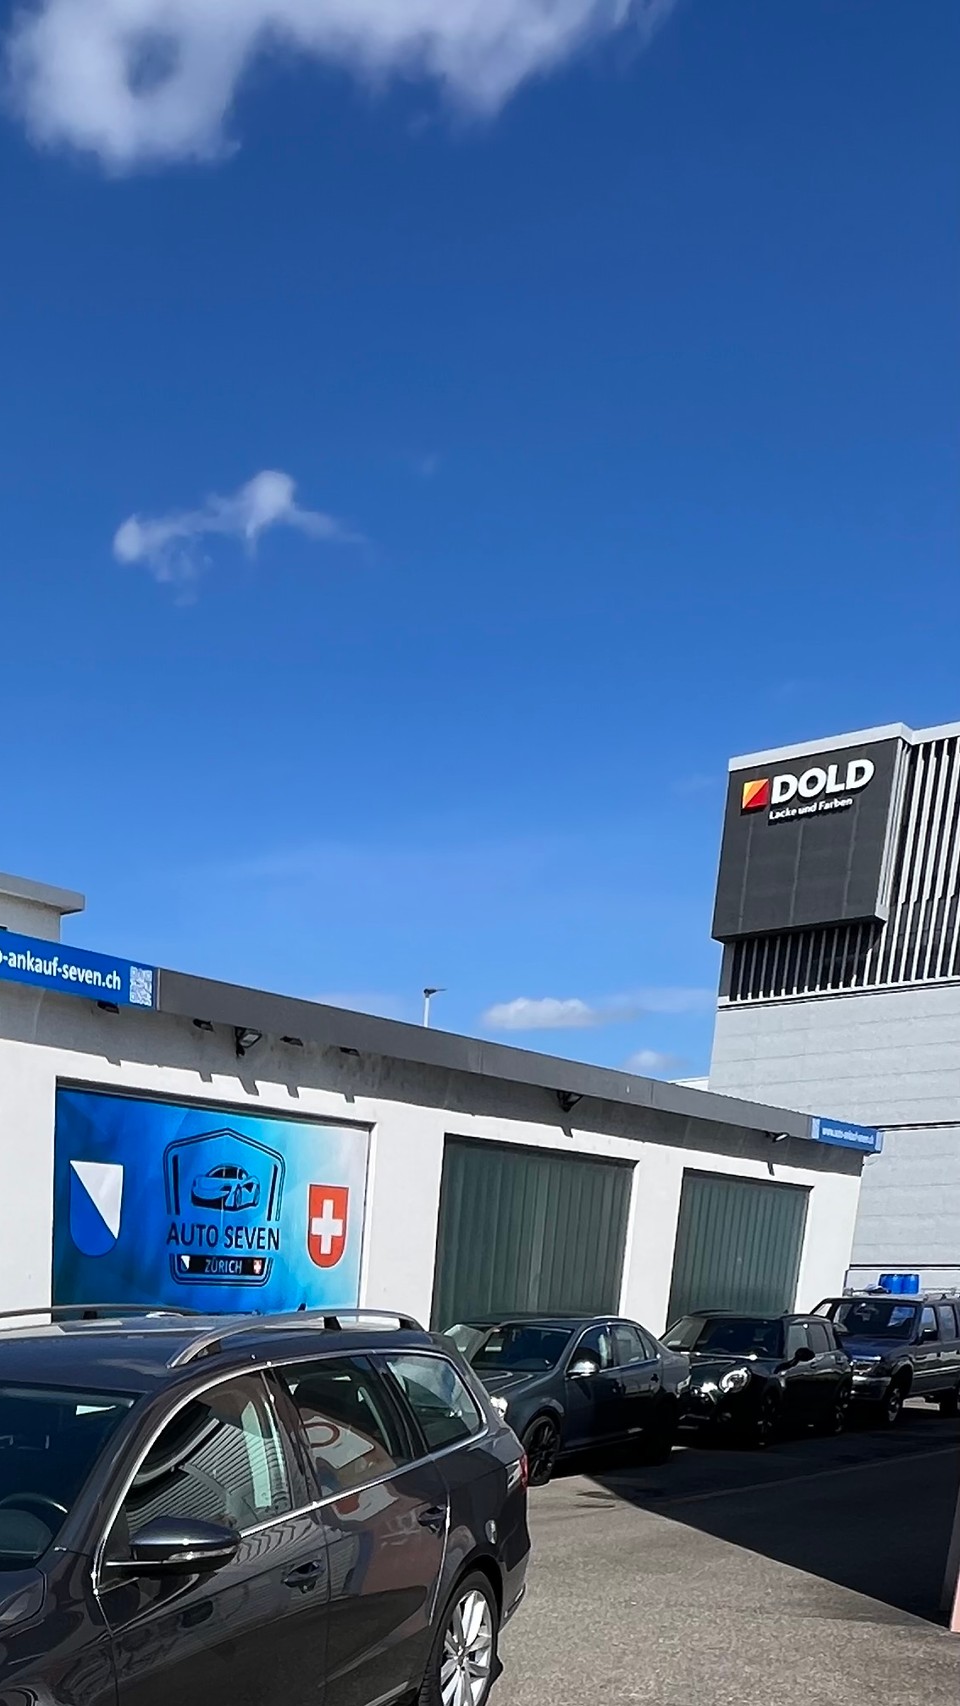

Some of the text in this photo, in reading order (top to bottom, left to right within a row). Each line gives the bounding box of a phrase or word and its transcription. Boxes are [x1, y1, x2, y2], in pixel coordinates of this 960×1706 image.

[771, 758, 875, 804] DOLD
[769, 798, 853, 820] Lacke und Farben
[166, 1221, 279, 1251] AUTO SEVEN
[204, 1257, 243, 1275] ZÜRICH
